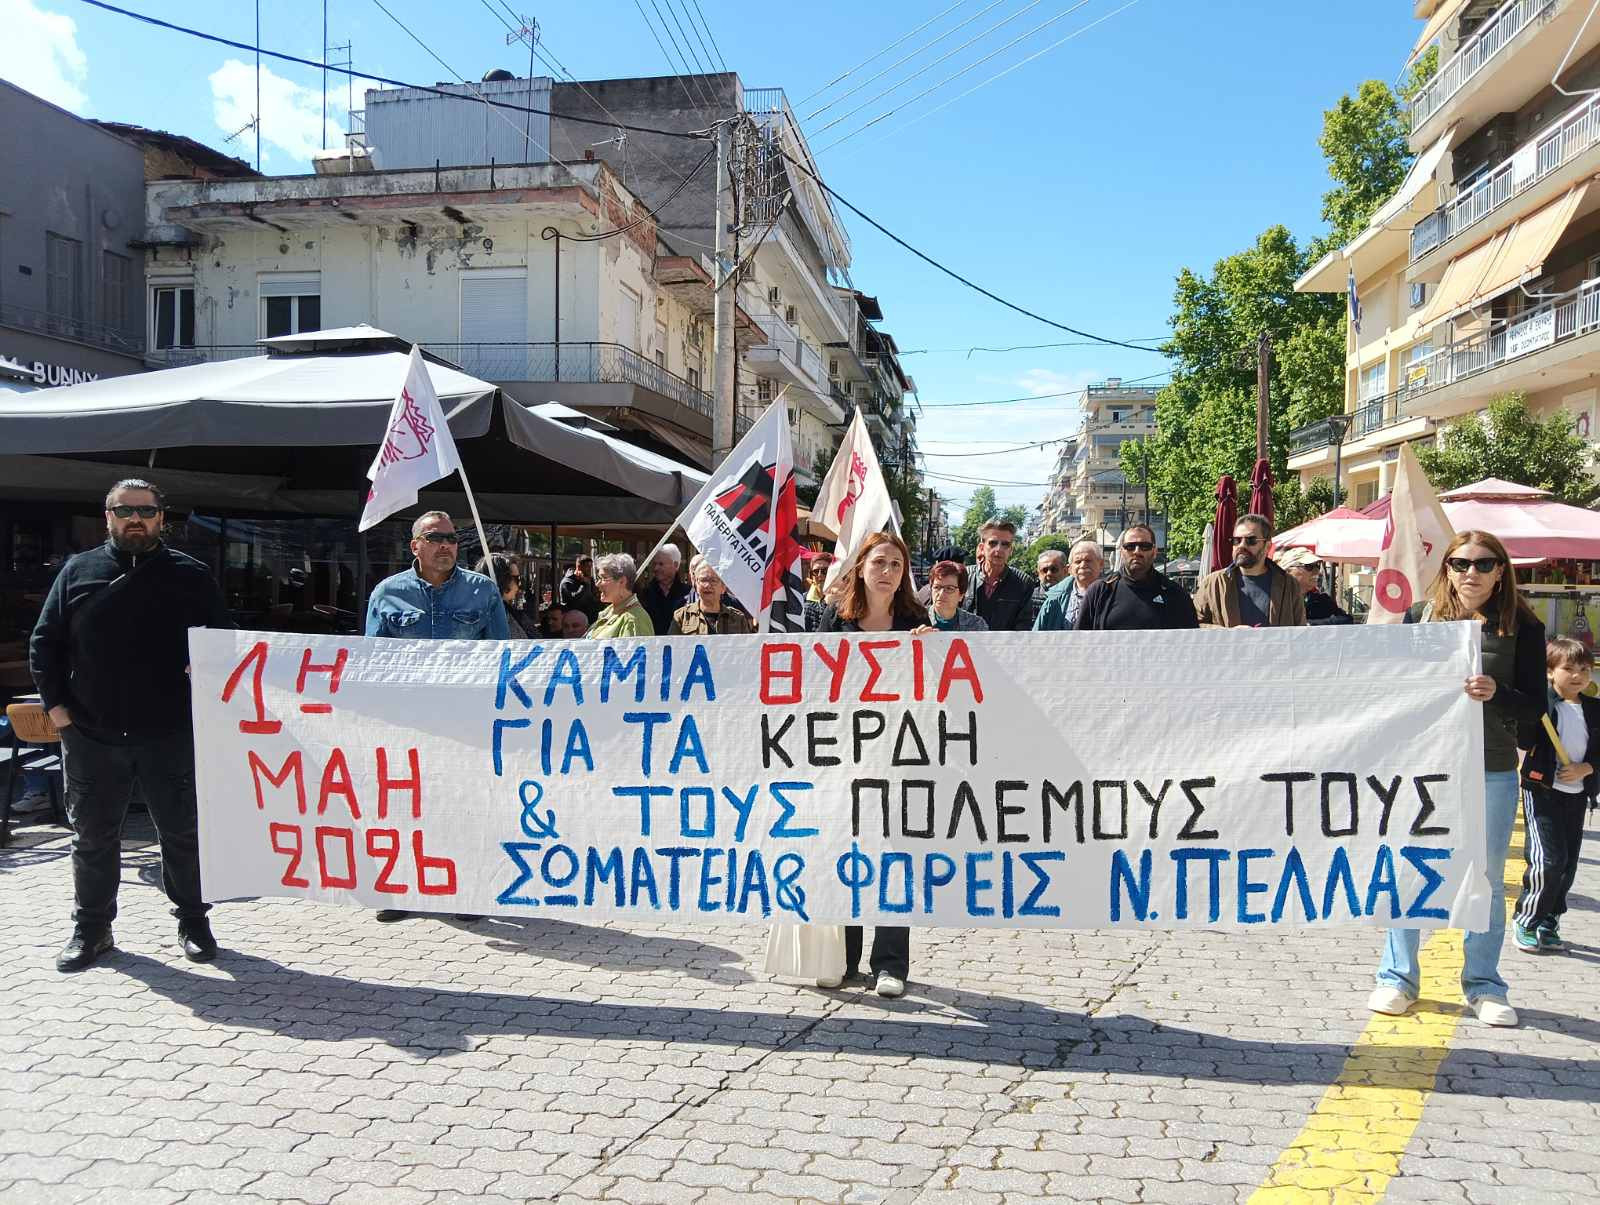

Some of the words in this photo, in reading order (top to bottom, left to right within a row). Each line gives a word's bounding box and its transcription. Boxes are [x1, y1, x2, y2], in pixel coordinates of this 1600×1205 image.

[703, 502, 762, 573] ΠΑΝΕΡΓΑΤΙΚΟ
[494, 643, 716, 710] ΚΑΜΙΑ
[759, 638, 984, 705] ΘΥΣΙΑ
[492, 717, 595, 777] ΓΙΑ
[623, 712, 711, 778] ΤΑ
[760, 709, 978, 769] ΚΕΡΔΗ
[247, 747, 421, 820] ΜΑΗ
[518, 779, 561, 840] &
[612, 780, 820, 842] ΤΟΥΣ
[851, 776, 1219, 844] ΠΟΛΕΜΟΥΣ
[1259, 771, 1452, 838] ΤΟΥΣ
[269, 822, 457, 896] 2026
[835, 842, 1066, 919] ΦΟΡΕΙΣ
